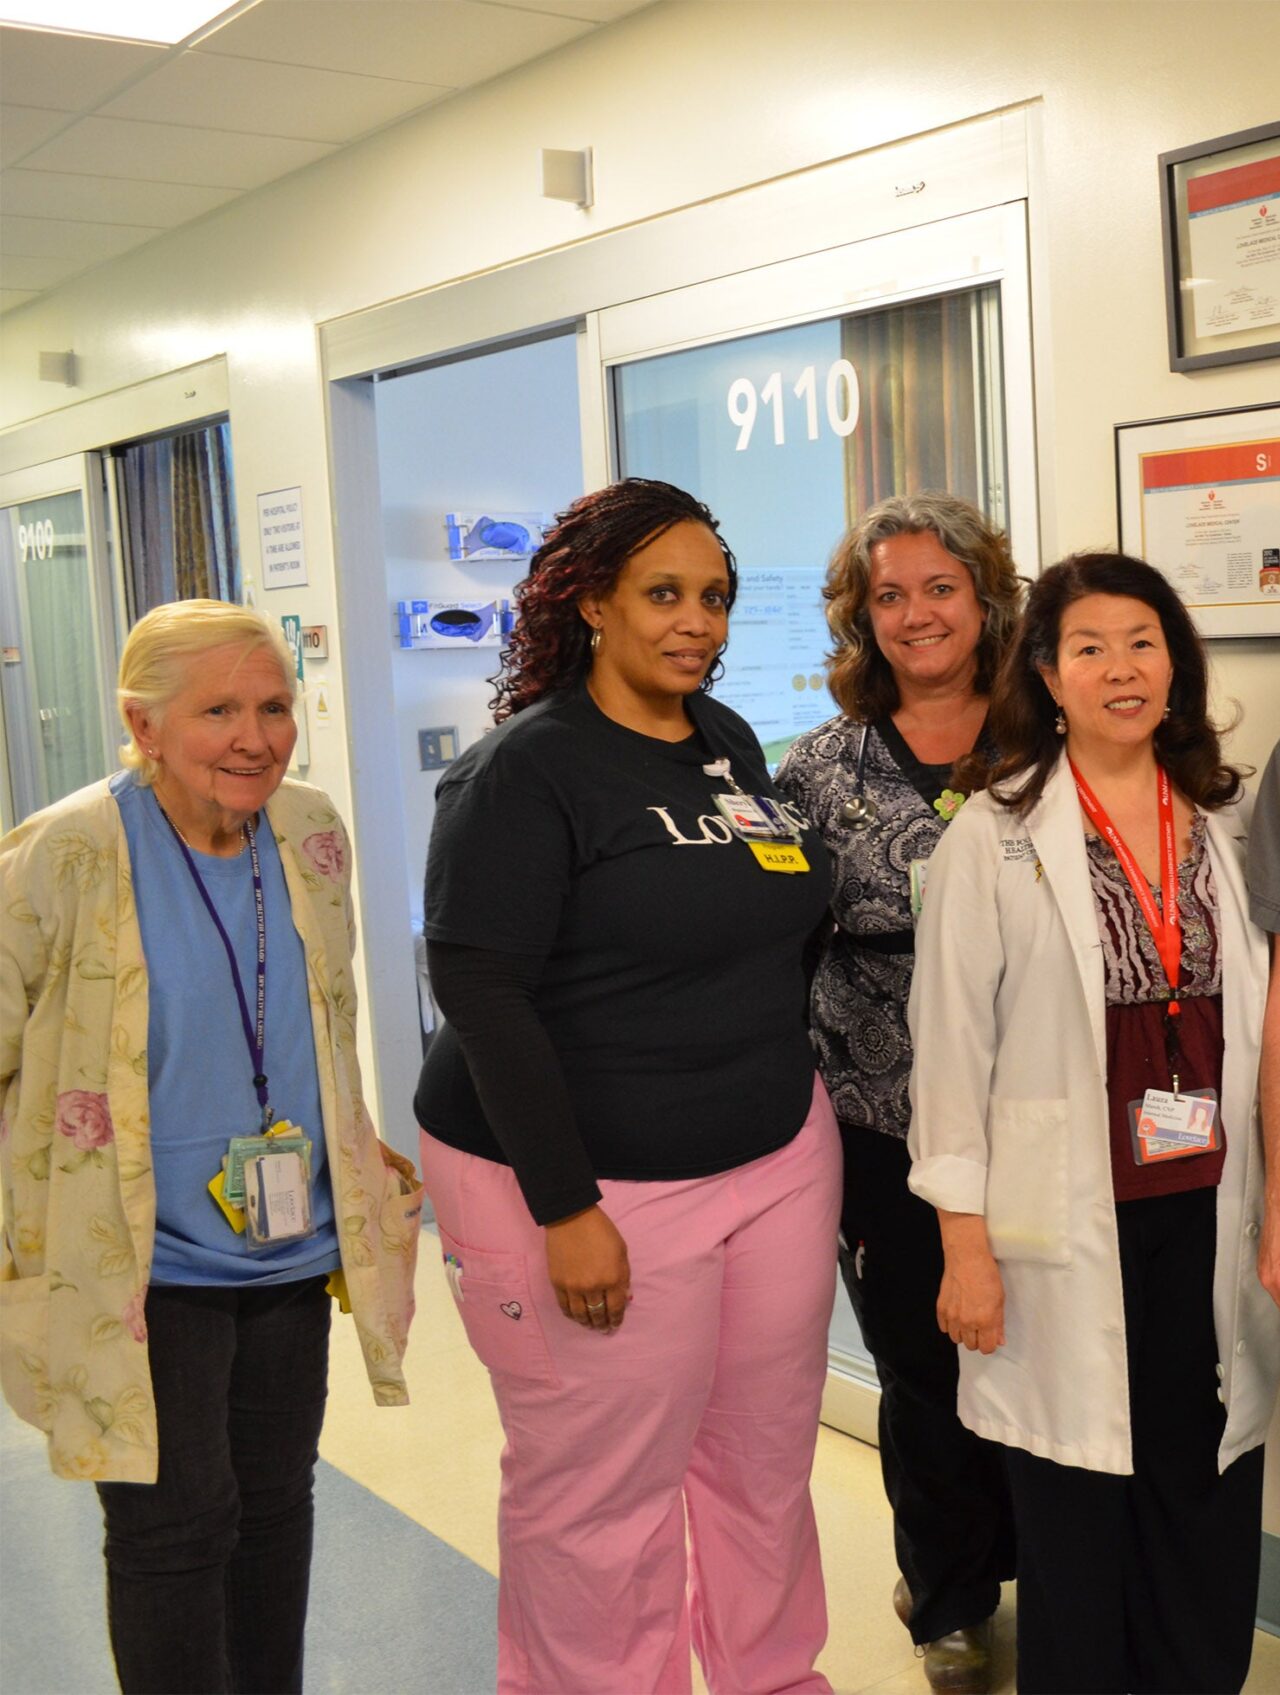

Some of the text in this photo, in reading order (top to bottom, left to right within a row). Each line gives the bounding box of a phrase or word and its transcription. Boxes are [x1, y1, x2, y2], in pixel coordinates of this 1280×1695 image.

[727, 358, 860, 452] 9110
[1256, 453, 1268, 472] S
[18, 519, 54, 563] 9109
